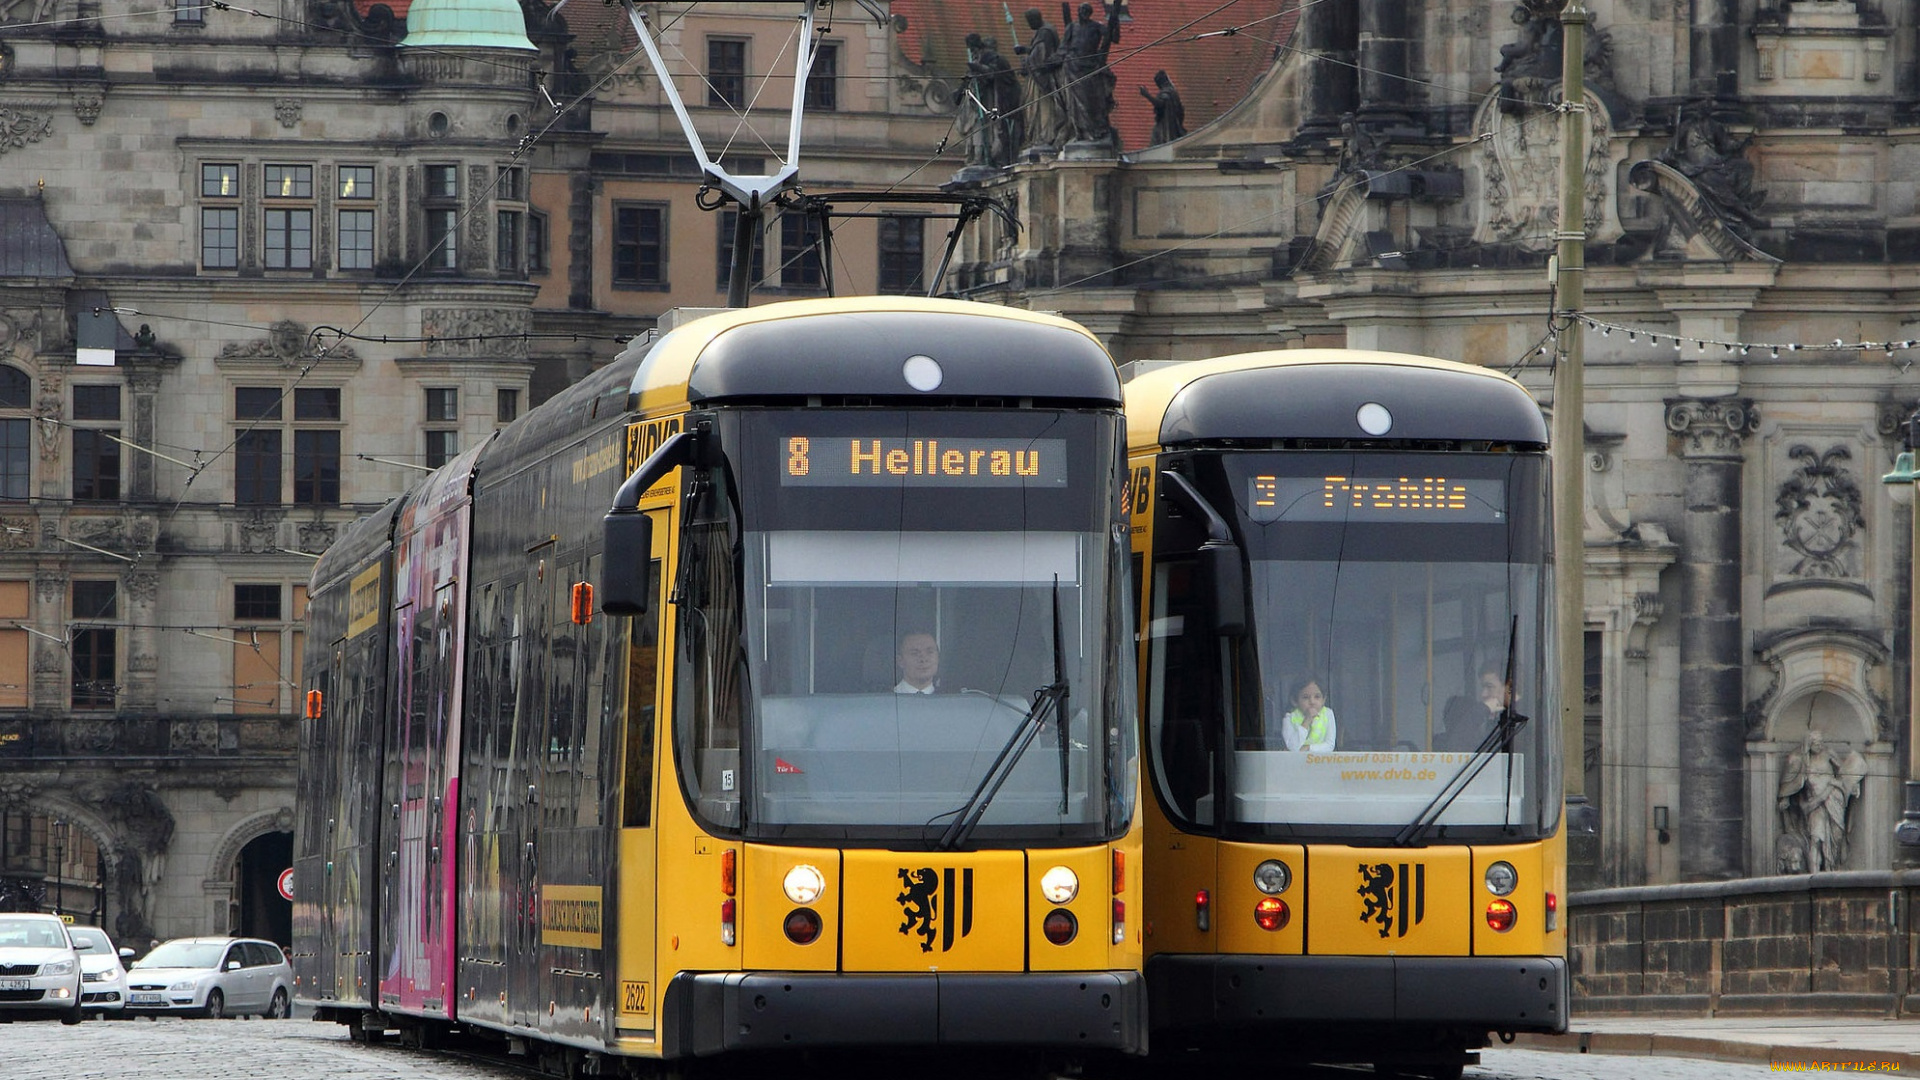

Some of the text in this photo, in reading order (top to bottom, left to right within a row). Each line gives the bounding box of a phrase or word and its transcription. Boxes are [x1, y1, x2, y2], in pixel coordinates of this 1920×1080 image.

[788, 437, 1040, 476] 8 Hellerau
[1306, 753, 1369, 764] Serviceruf
[1372, 753, 1400, 763] 0351
[1411, 753, 1418, 764] 8
[1421, 753, 1436, 764] 57
[1441, 754, 1453, 764] 10
[724, 773, 733, 787] 15
[1341, 768, 1437, 780] www.dvb.de
[625, 983, 646, 1011] 2622
